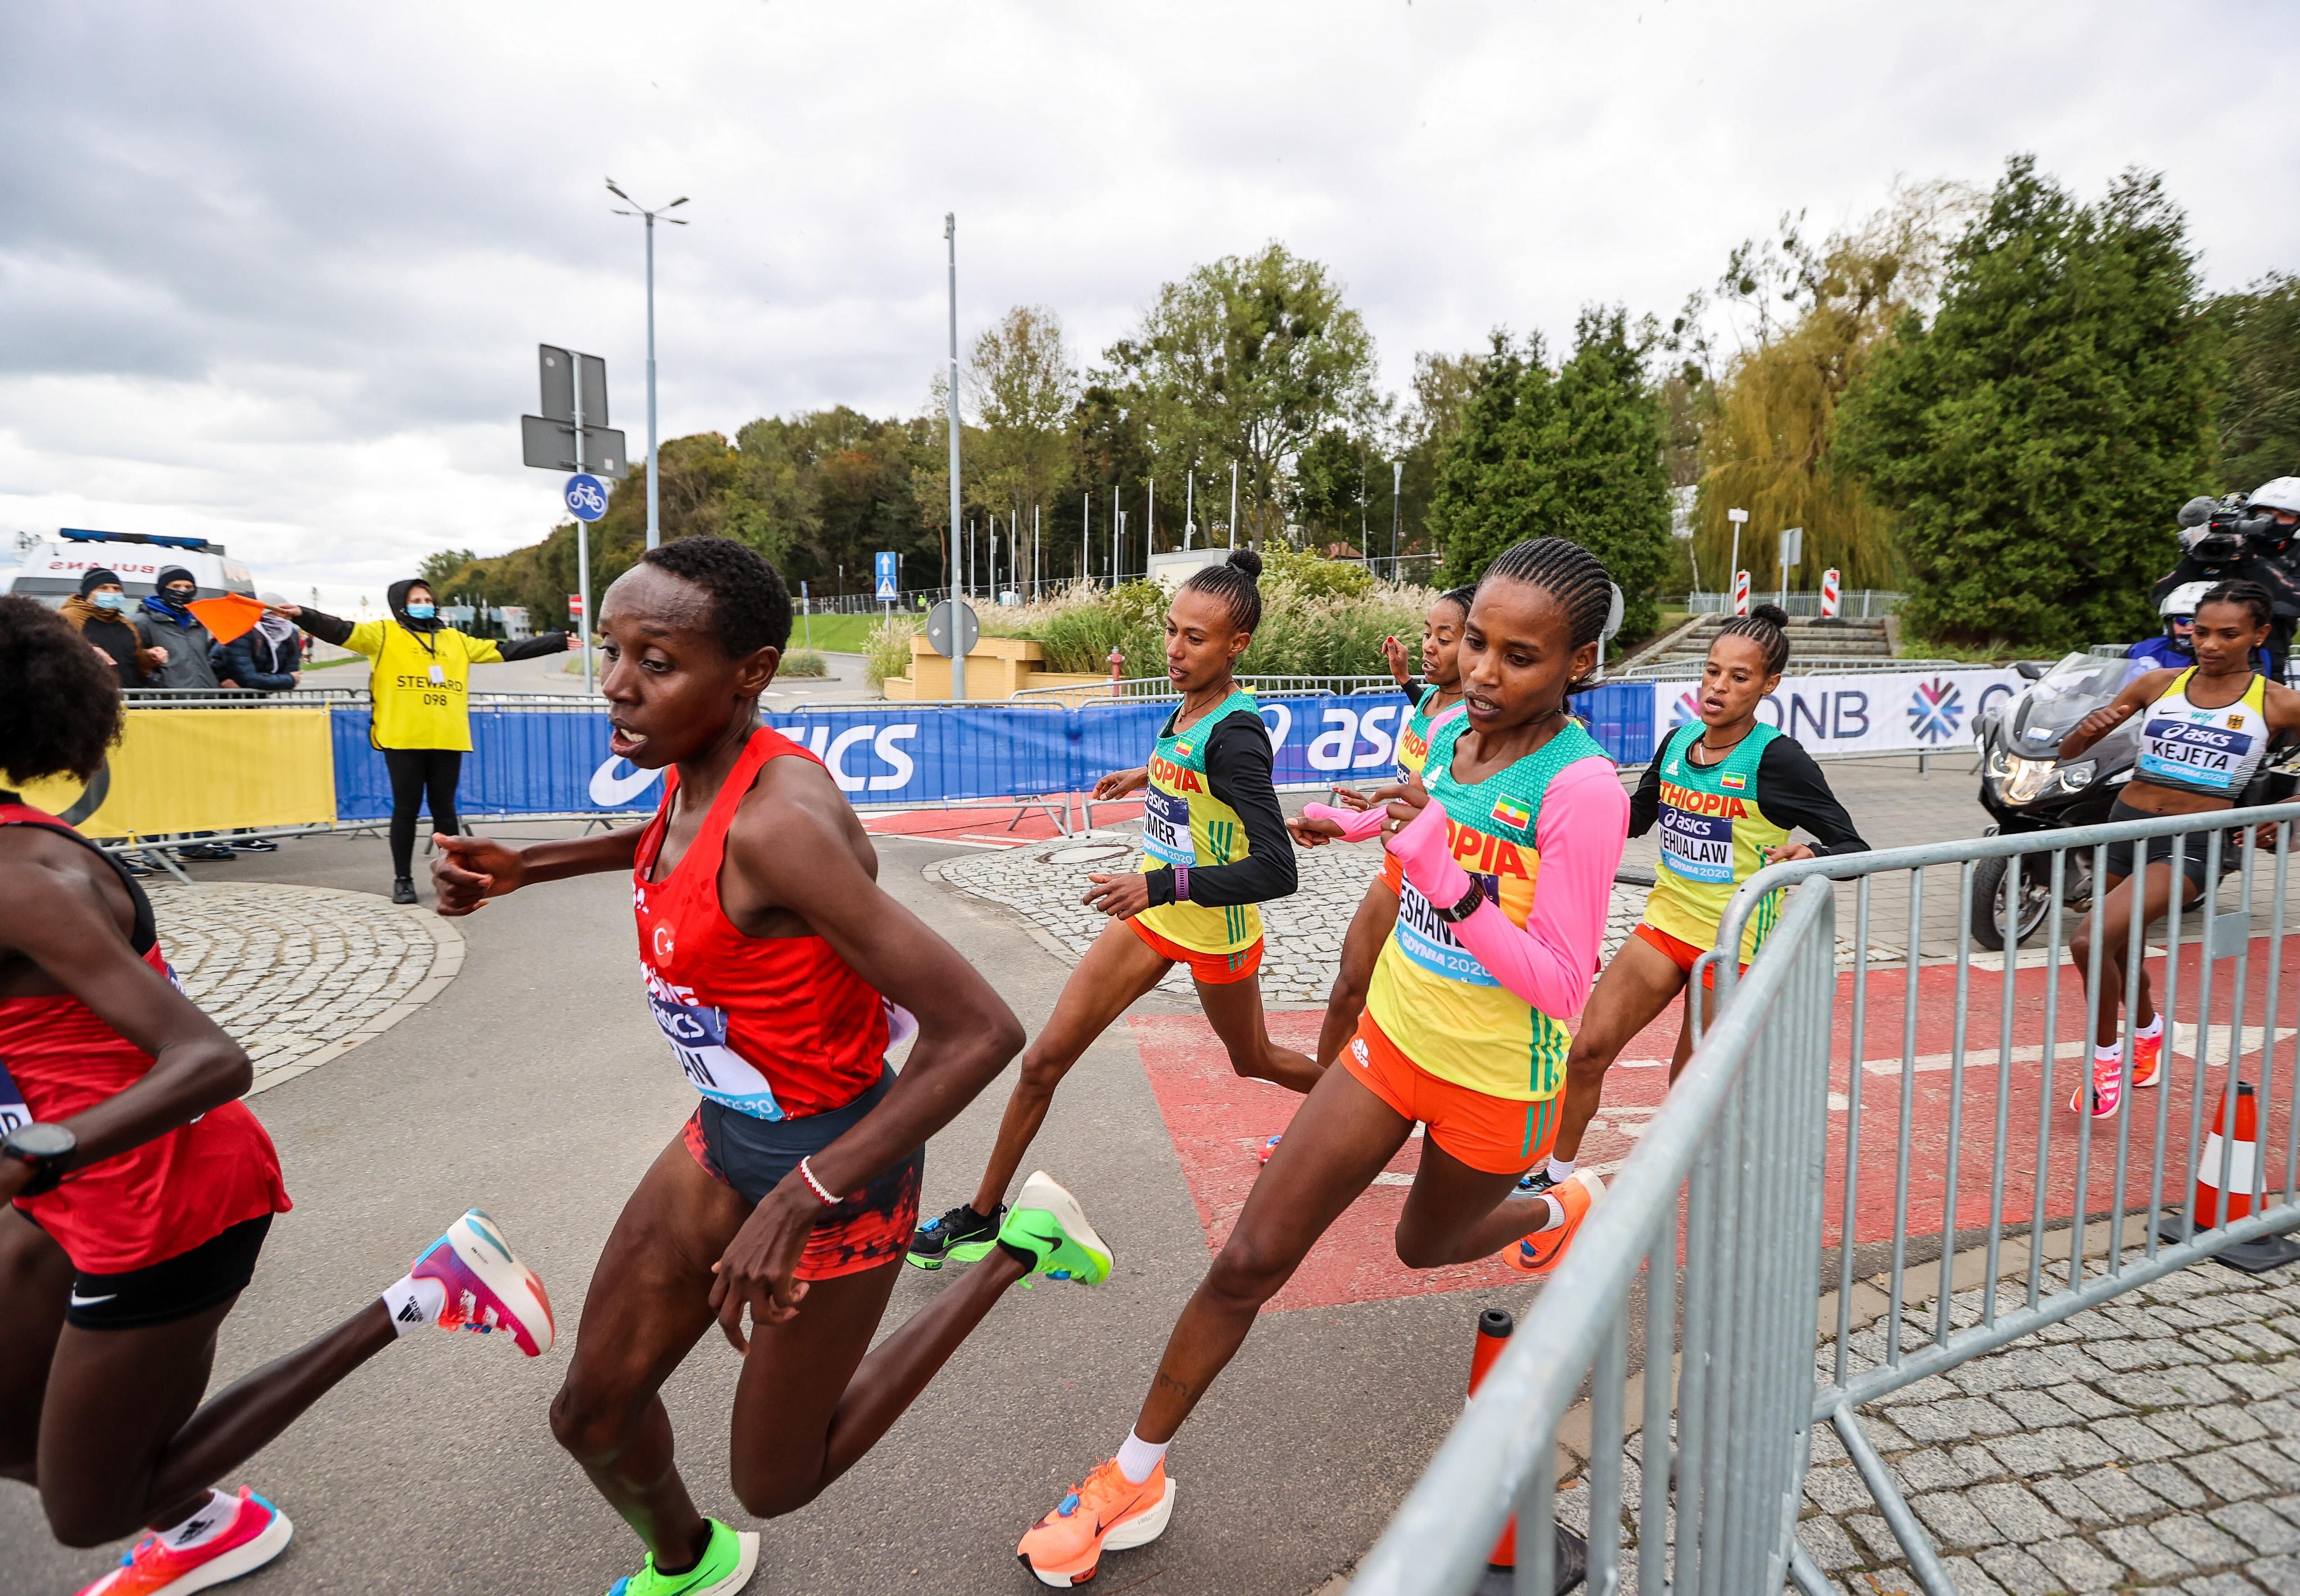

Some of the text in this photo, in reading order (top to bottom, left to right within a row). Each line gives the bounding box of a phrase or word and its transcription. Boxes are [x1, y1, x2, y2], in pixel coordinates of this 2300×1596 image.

[397, 675, 463, 692] STEWARD
[424, 694, 447, 706] 098
[2152, 740, 2229, 770] KEJETA
[2200, 772, 2228, 782] 2020
[1143, 838, 1193, 865] GDYNIA 2020
[1660, 827, 1727, 864] YEHUALAW
[1669, 857, 1730, 878] GDYNIA 2020
[1402, 931, 1446, 967] GDYNIA
